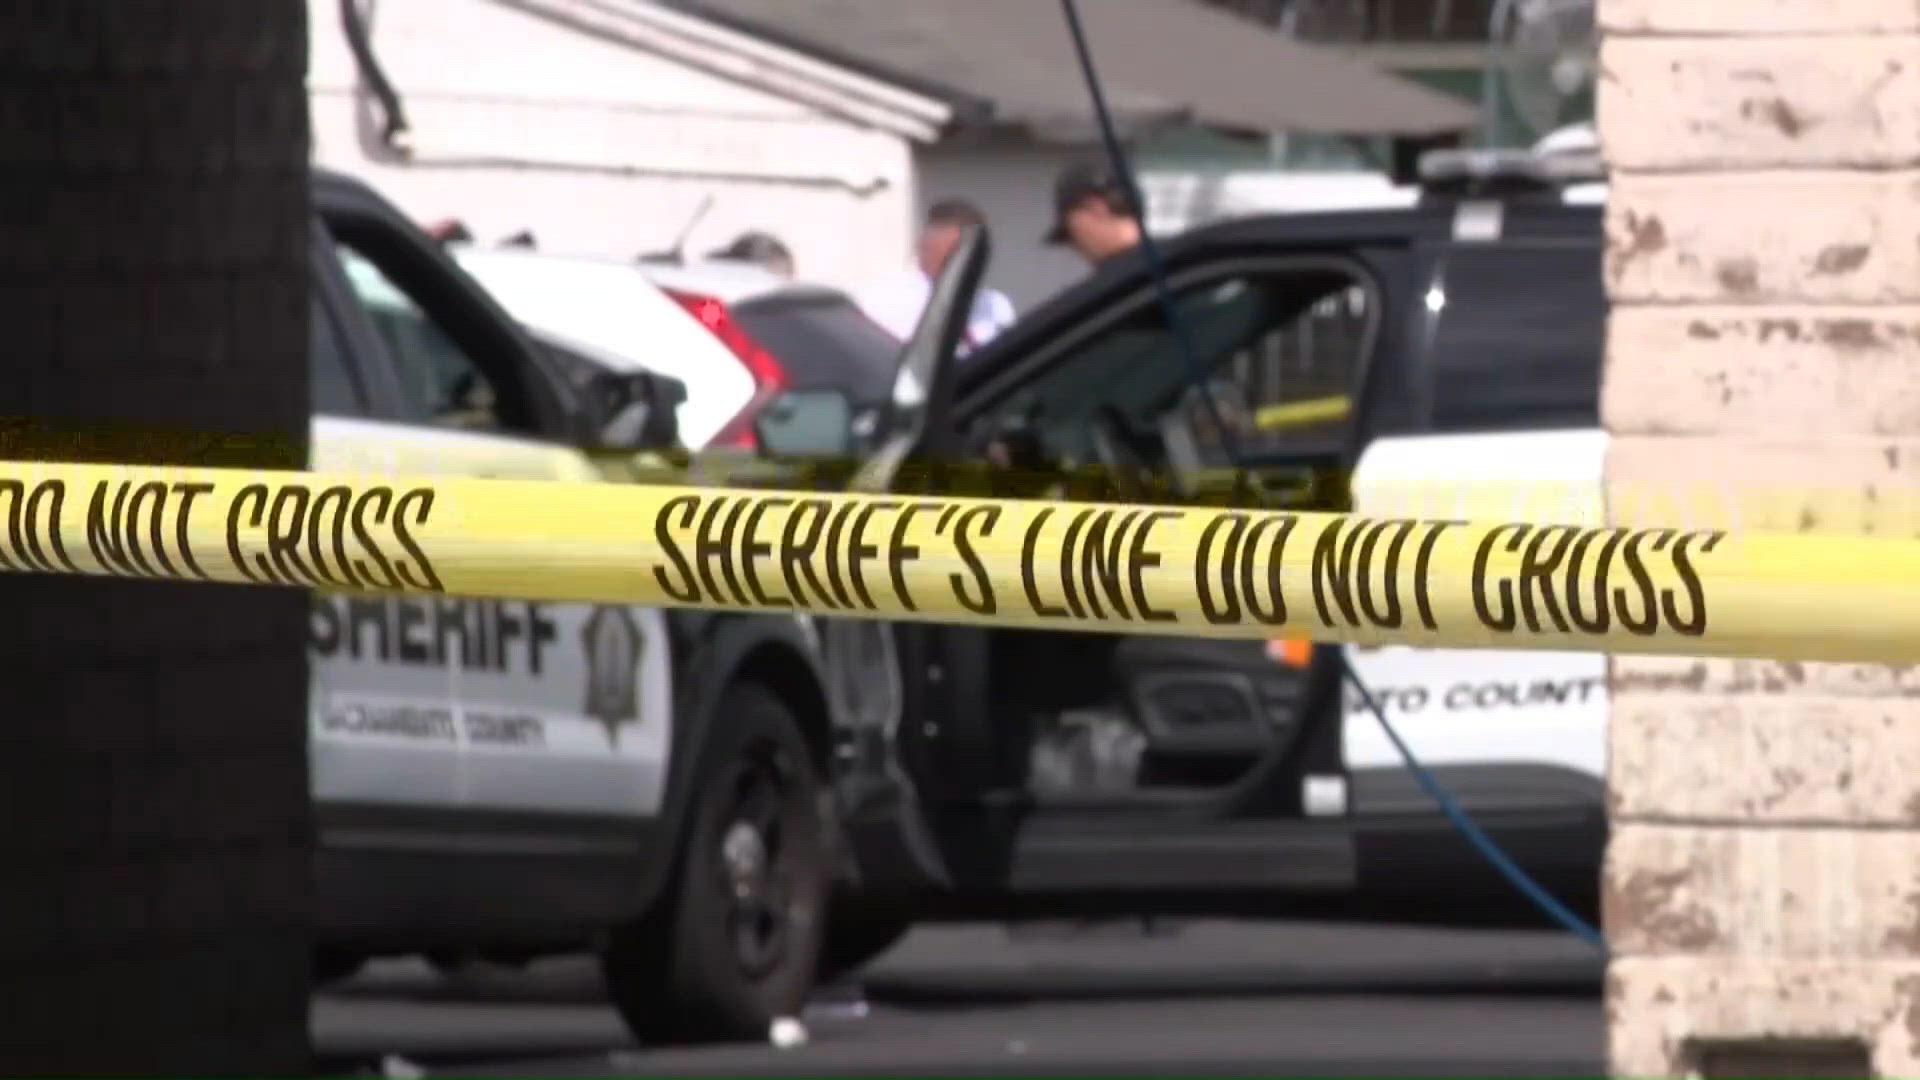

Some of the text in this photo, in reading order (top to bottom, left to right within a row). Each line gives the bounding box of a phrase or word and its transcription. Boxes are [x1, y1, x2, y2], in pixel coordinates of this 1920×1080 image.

[0, 479, 1727, 635] DO NOT CROSS SHERIFF'S LINE DO NOT CROSS
[1444, 677, 1606, 711] COUNT
